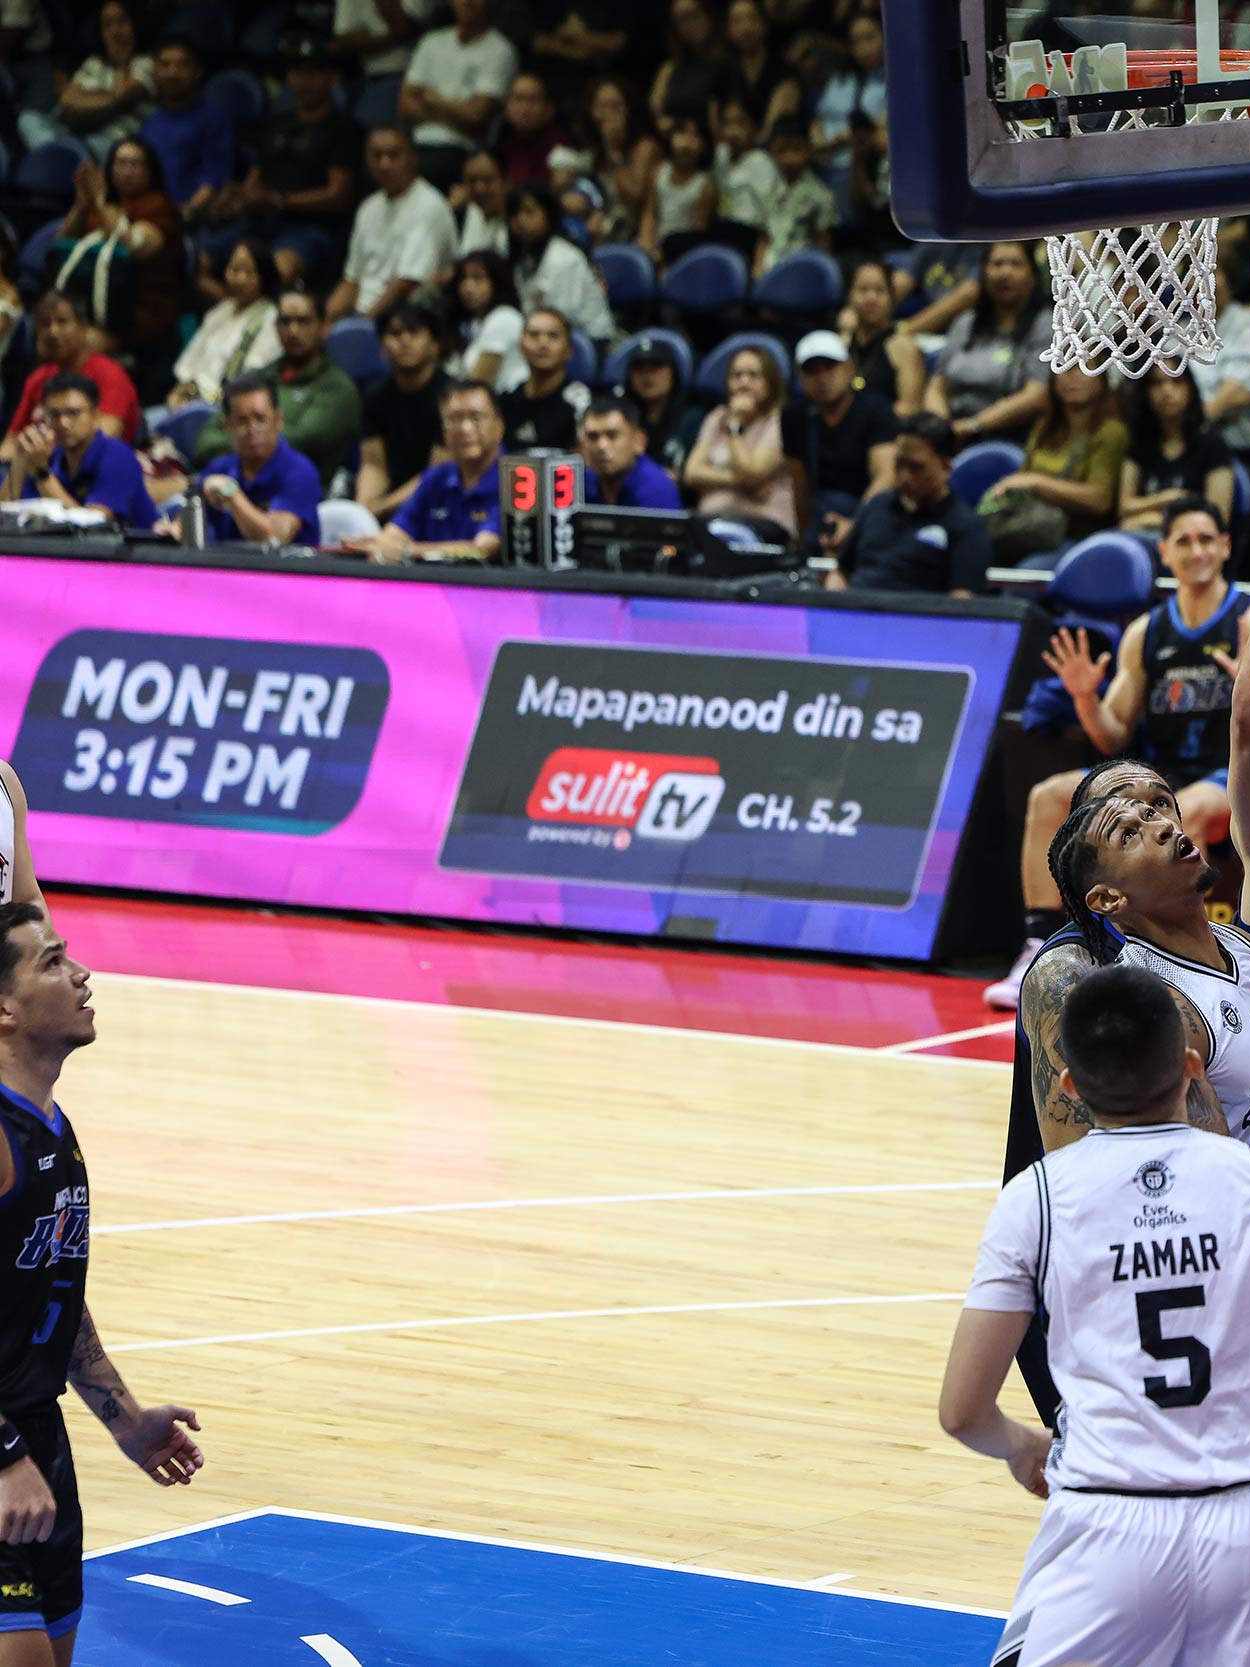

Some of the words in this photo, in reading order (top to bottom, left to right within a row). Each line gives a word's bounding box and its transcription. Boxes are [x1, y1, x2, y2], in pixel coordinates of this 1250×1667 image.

[513, 465, 537, 511] 3
[554, 464, 575, 509] 3
[61, 655, 355, 740] MON-FRI
[517, 674, 789, 733] Mapapanood
[793, 693, 864, 739] din
[871, 707, 923, 744] sa
[63, 728, 197, 800] 3:15
[202, 739, 311, 810] PM
[540, 760, 650, 818] sulit
[653, 778, 710, 831] tv
[736, 792, 799, 831] CH.
[805, 798, 862, 836] 5.2
[1133, 1210, 1187, 1230] Organics
[1143, 1204, 1168, 1217] Ever
[1109, 1233, 1221, 1282] ZAMAR
[1135, 1285, 1211, 1409] 5
